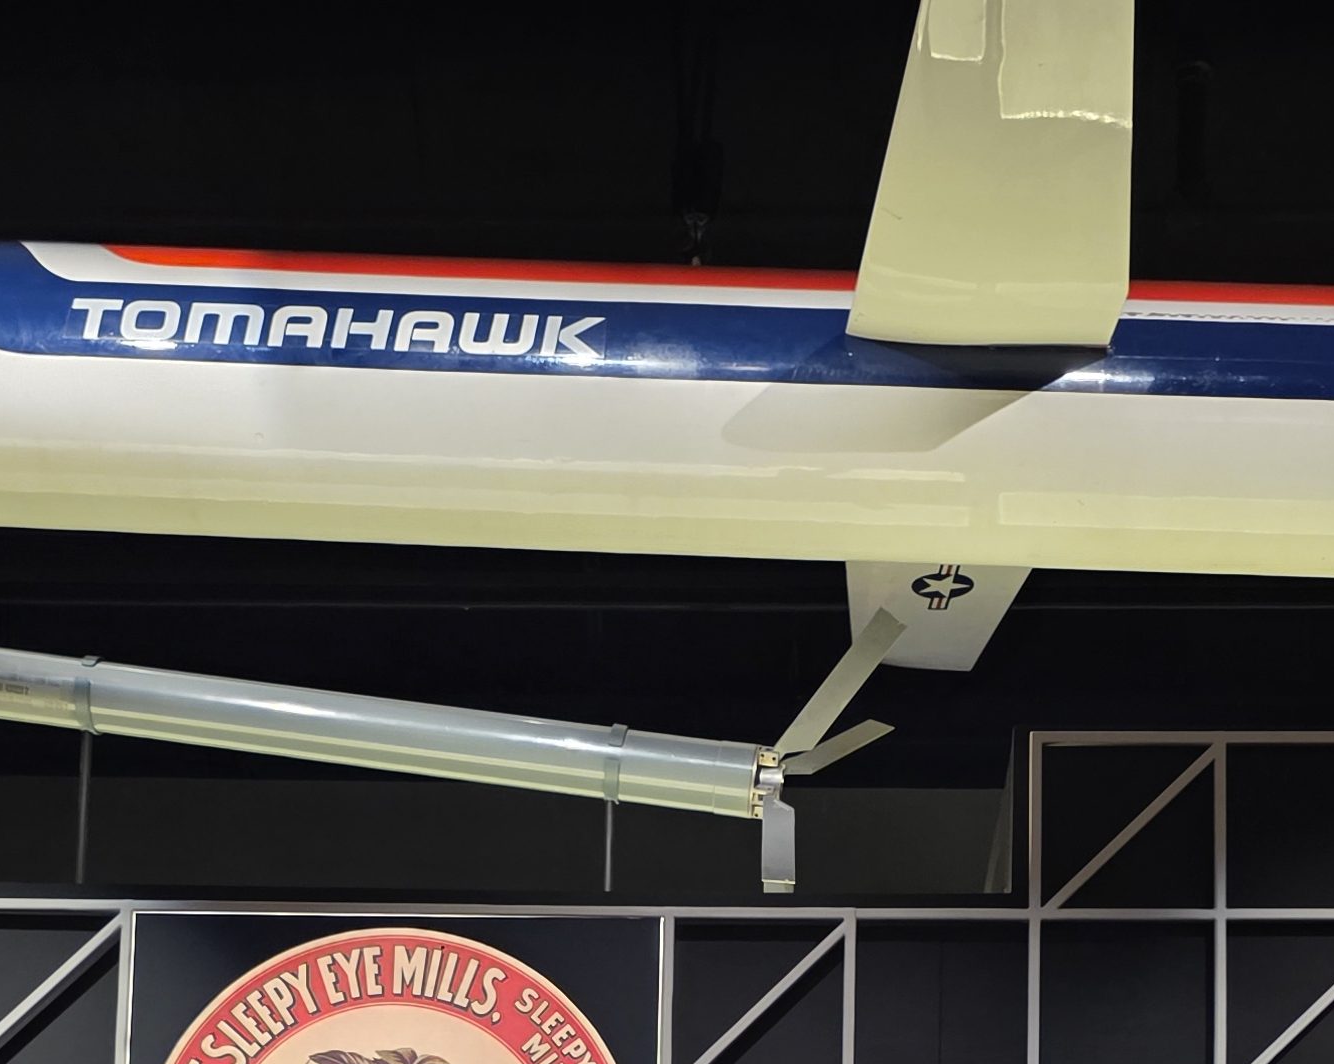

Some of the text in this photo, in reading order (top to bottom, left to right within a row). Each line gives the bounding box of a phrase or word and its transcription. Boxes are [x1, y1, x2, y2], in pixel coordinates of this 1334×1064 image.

[71, 298, 606, 358] TOMAHAWK
[317, 945, 384, 1006] EYE
[392, 944, 507, 1025] MILLS,
